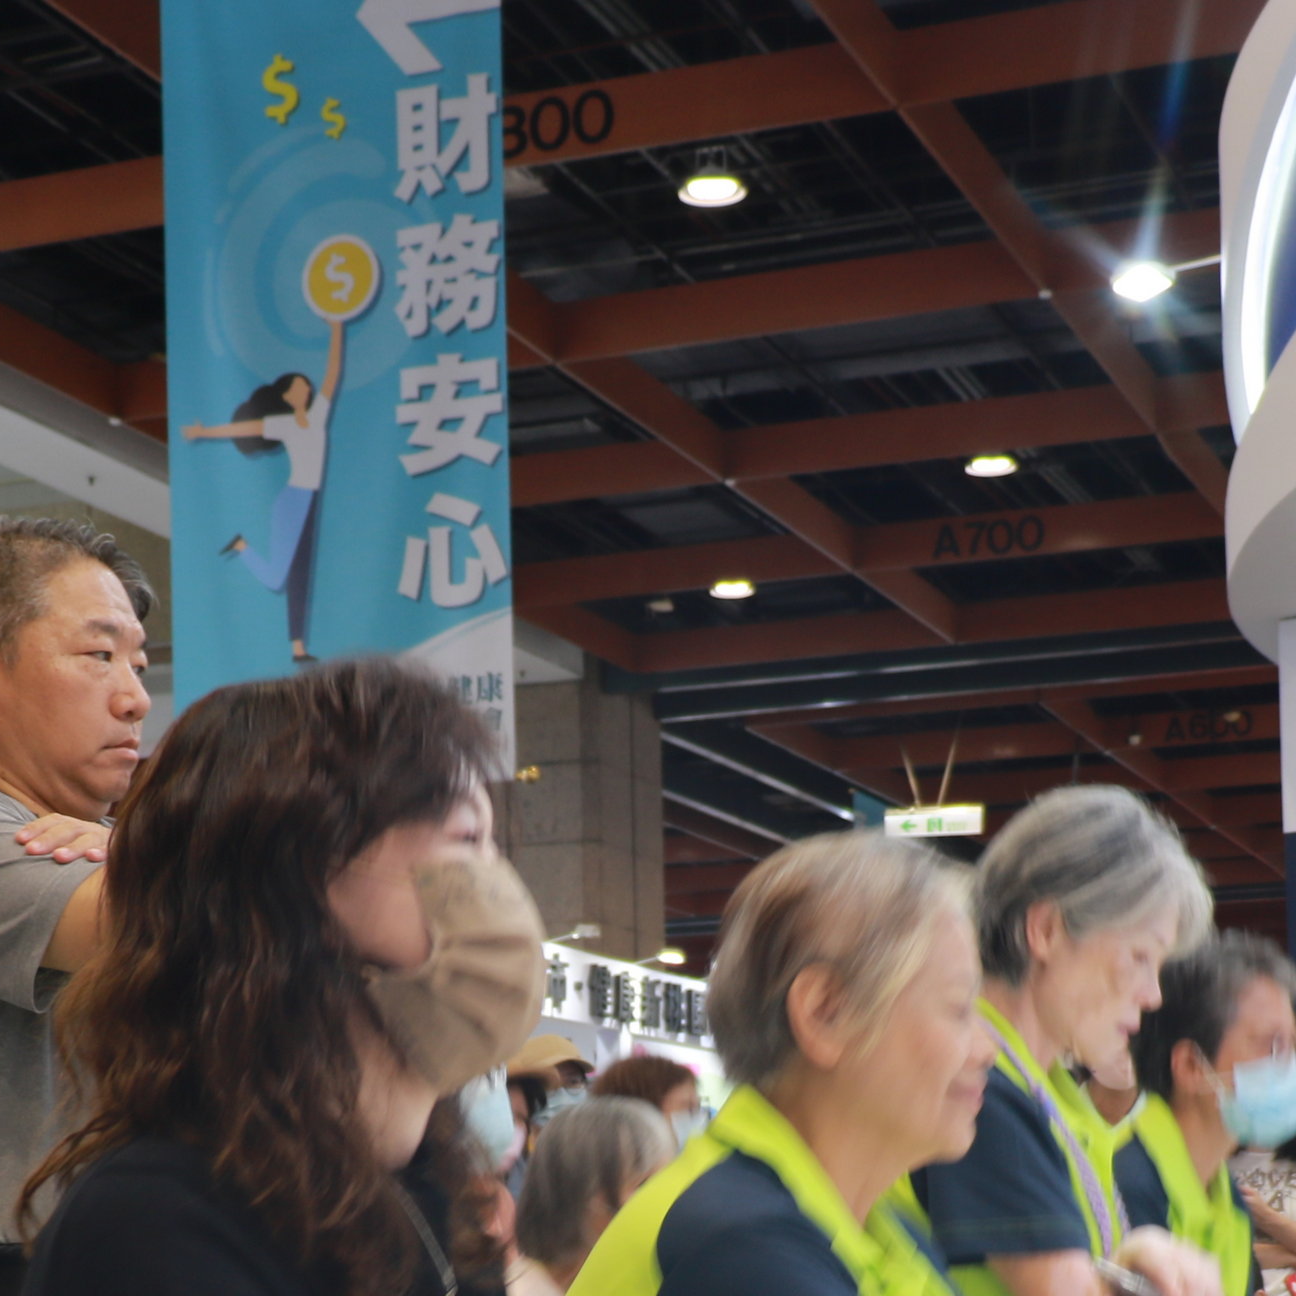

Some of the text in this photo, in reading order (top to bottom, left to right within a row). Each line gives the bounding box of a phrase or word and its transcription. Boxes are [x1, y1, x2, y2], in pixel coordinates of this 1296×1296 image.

[394, 72, 508, 608] 財務安心
[932, 514, 1045, 561] A700
